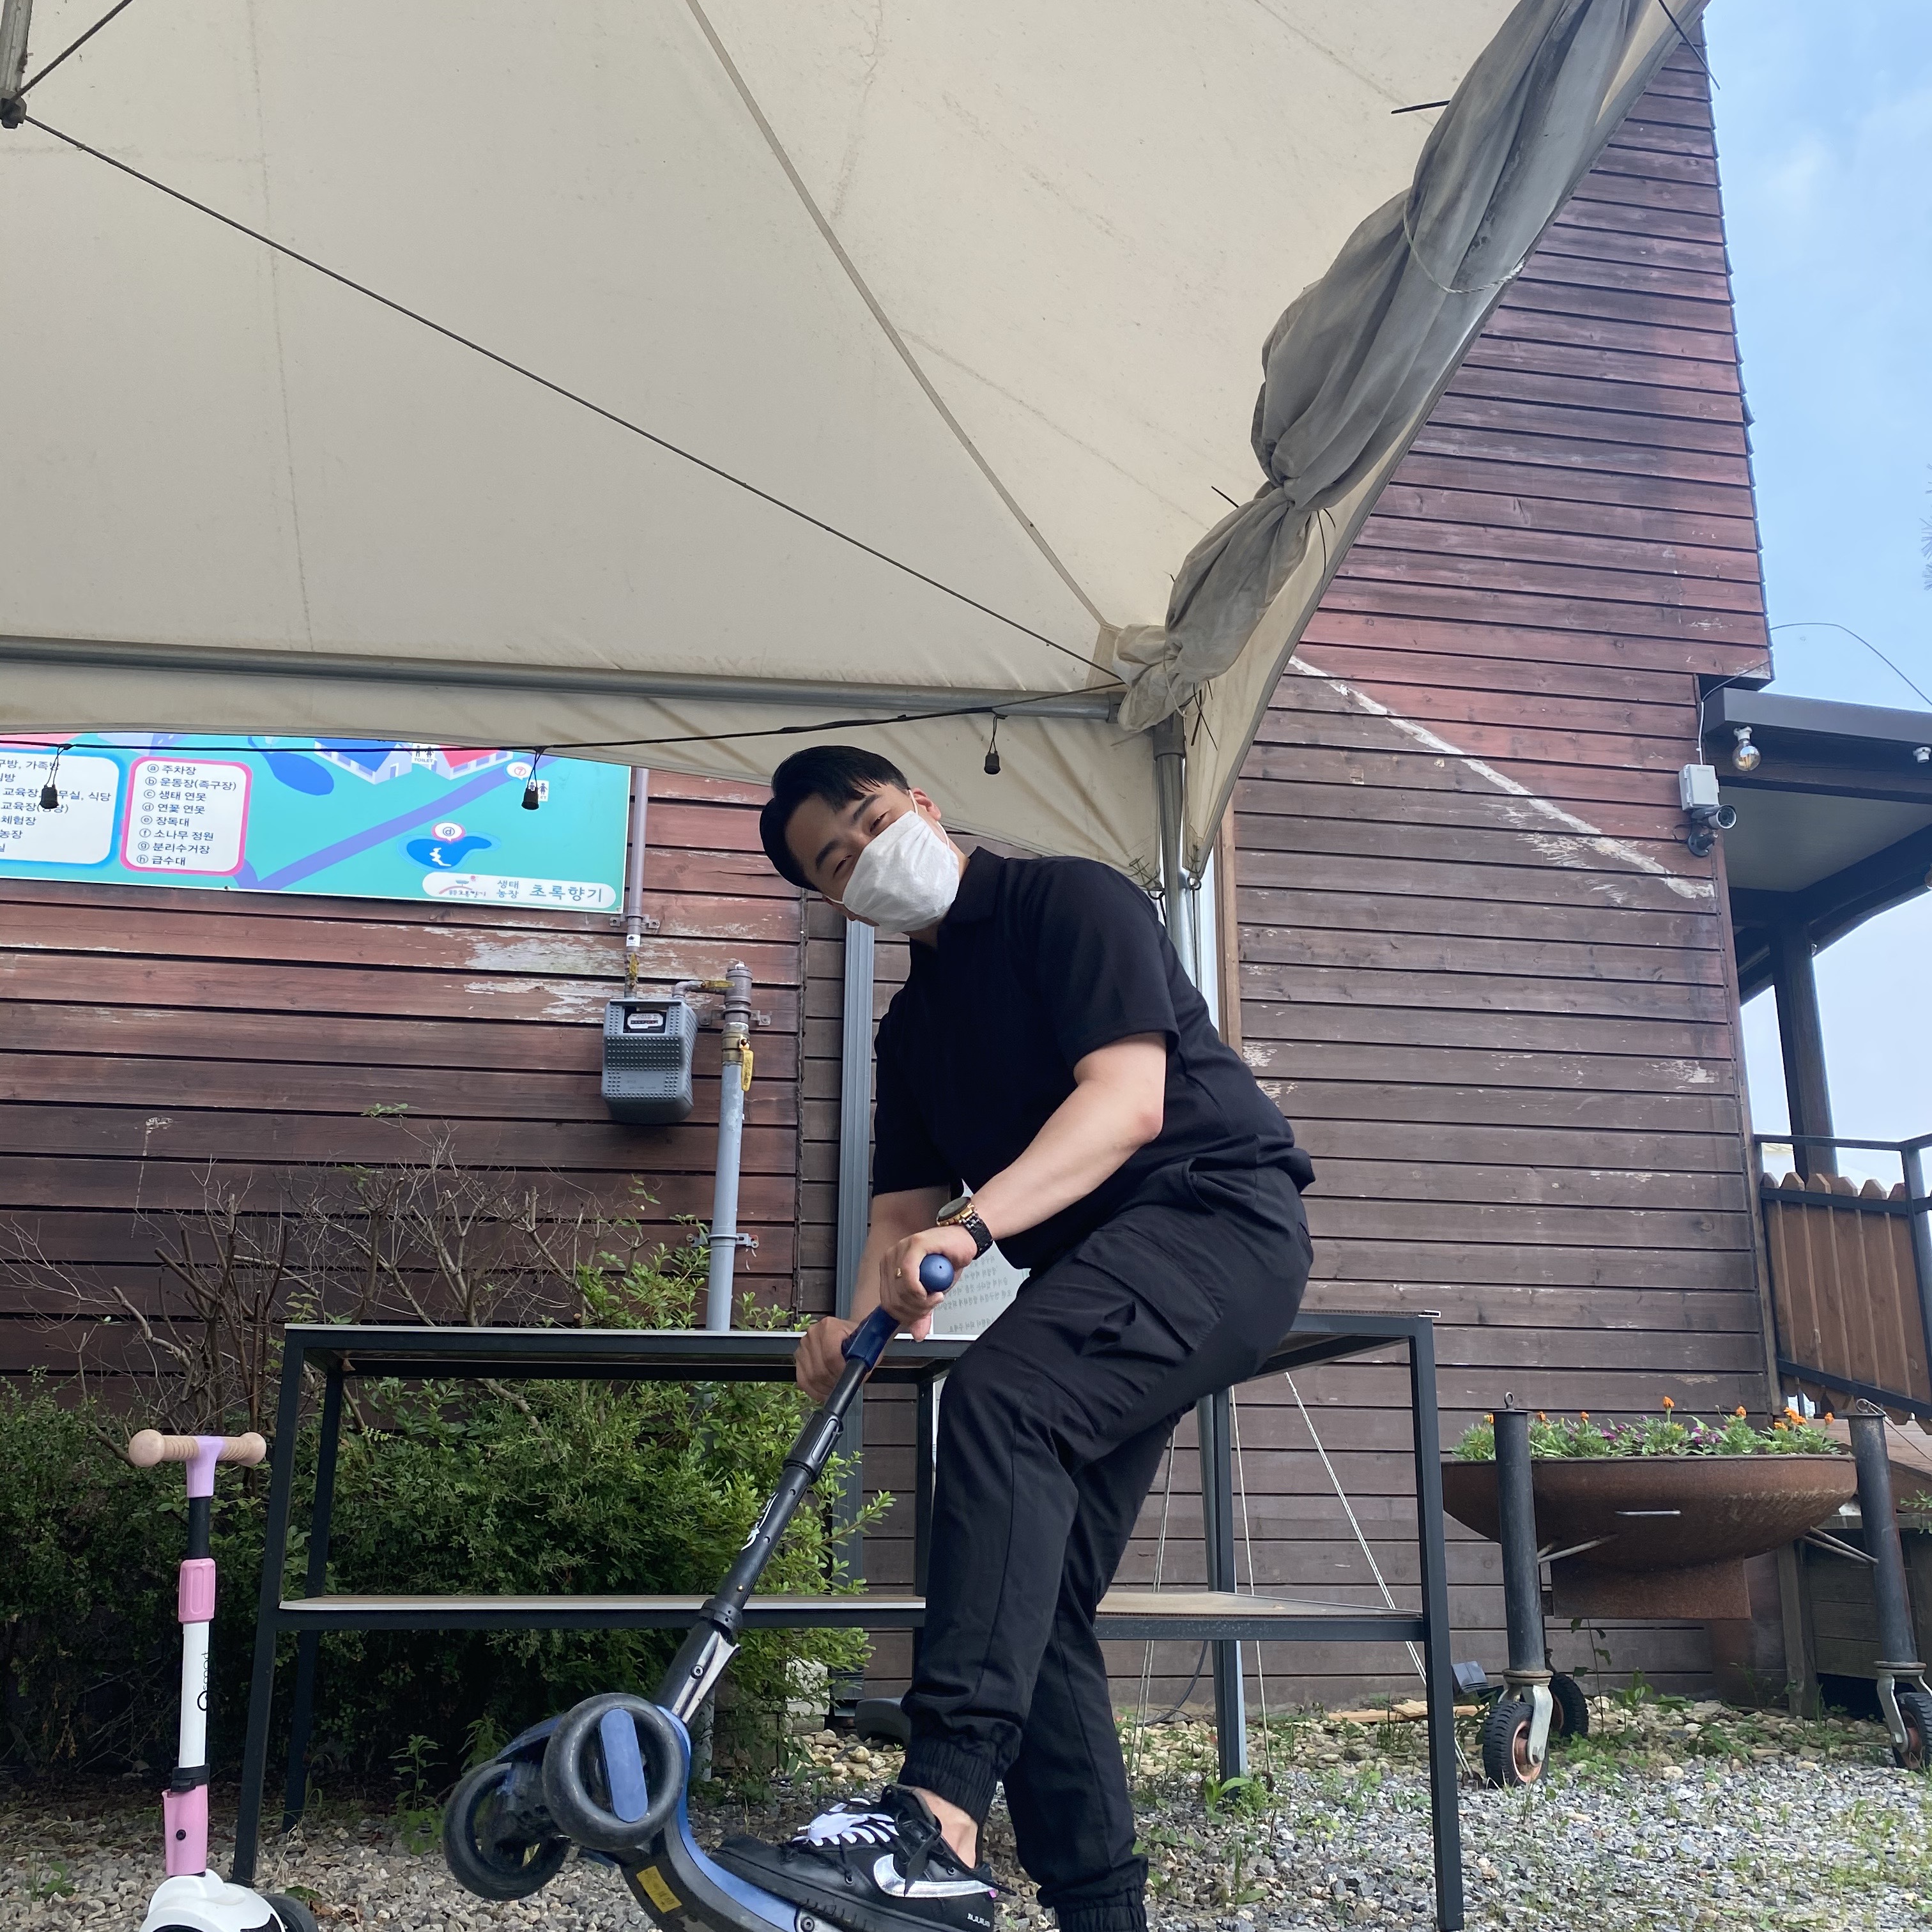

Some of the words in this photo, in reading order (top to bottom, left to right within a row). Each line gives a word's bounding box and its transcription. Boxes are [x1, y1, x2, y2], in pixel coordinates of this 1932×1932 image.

[162, 765, 196, 775] 주차장
[160, 778, 236, 791] 운동장(족구장)
[88, 792, 111, 802] 식당
[159, 790, 181, 800] 생태
[185, 792, 206, 801] 연못
[158, 804, 180, 813] 연꽃
[183, 805, 206, 815] 연못
[1, 816, 36, 825] 체험장
[156, 816, 190, 827] 장독대
[153, 829, 188, 839] 소나무
[192, 831, 214, 841] 정원
[153, 842, 210, 854] 분리수거장
[152, 855, 186, 866] 급수대
[497, 880, 519, 889] 생태
[496, 891, 519, 899] 농장
[529, 884, 602, 902] 초록향기
